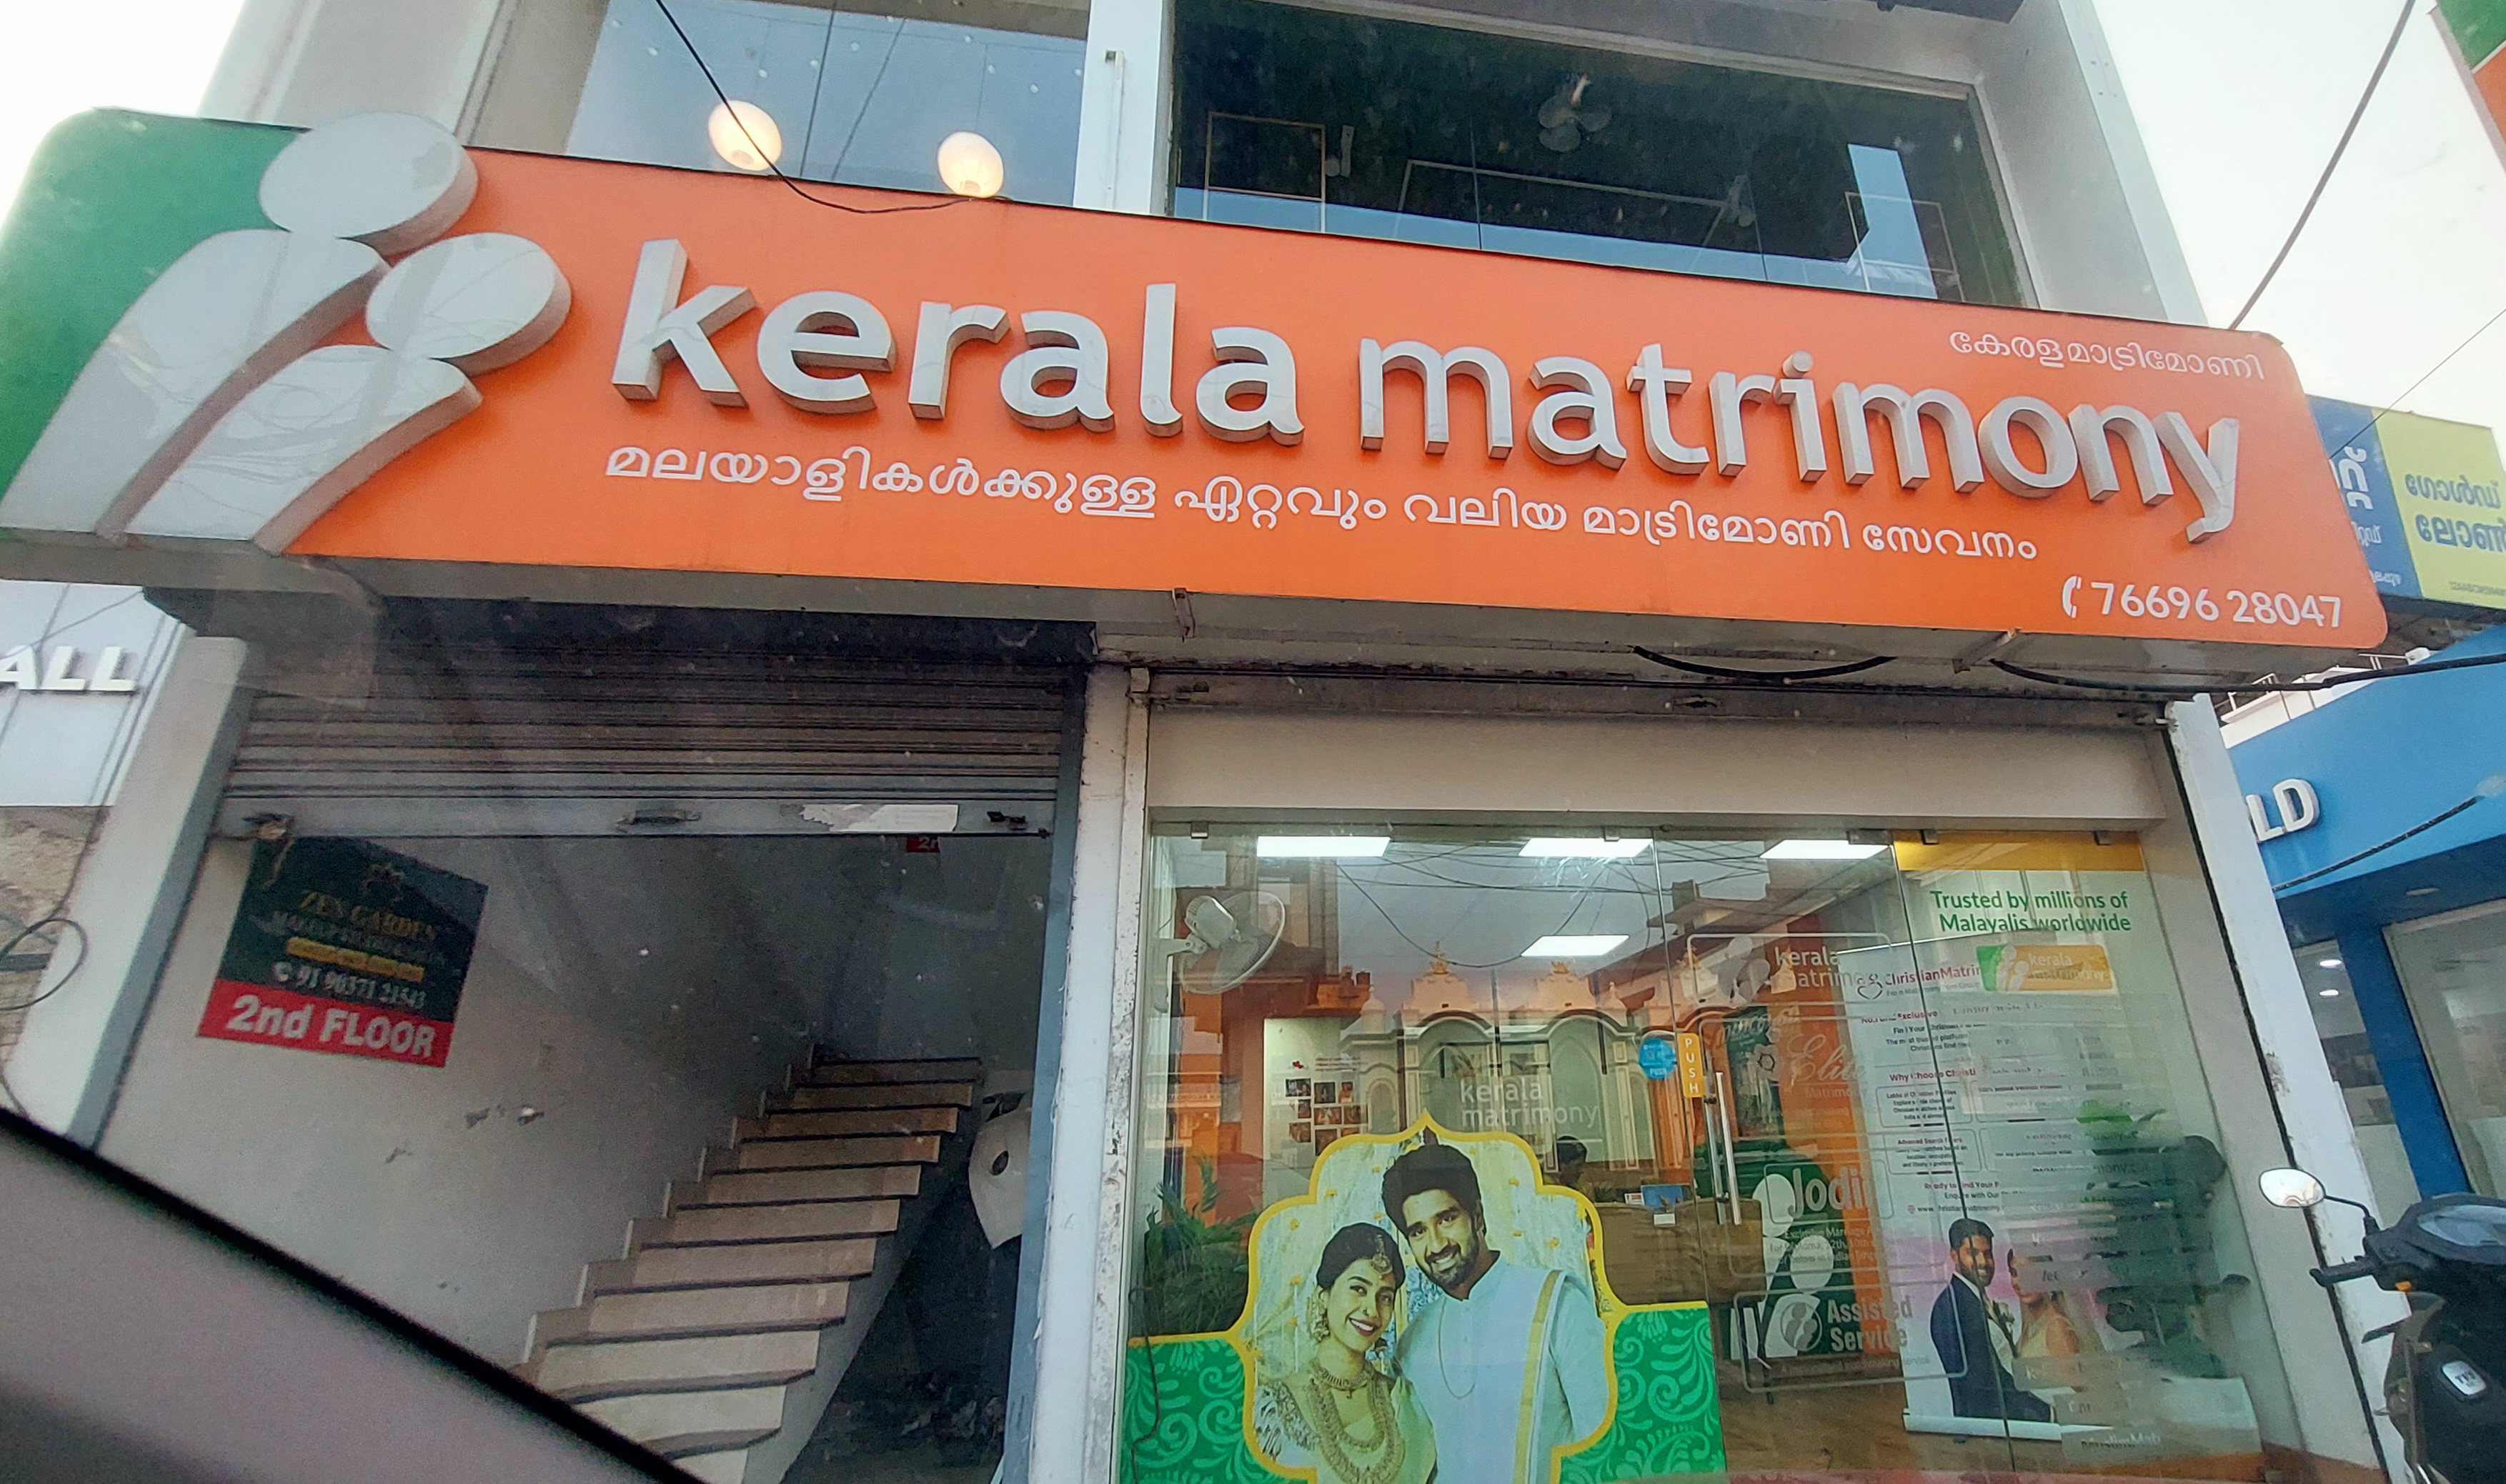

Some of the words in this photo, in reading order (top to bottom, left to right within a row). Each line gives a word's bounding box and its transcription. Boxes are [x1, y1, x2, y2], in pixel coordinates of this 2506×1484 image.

[612, 237, 1304, 447] kerala
[1358, 337, 2239, 544] matrimony
[605, 445, 1157, 519] മലയാളികൾക്കുള്ള
[1175, 475, 1387, 529] ഏറ്റവും
[1404, 488, 1567, 528] വലിയ
[1583, 500, 1851, 549] മാട്രിമോണി
[1862, 522, 2037, 560] സേവനം
[2090, 581, 2220, 621] 76696
[2227, 589, 2341, 627] 28047
[1929, 890, 2002, 908] Trusted
[2007, 891, 2029, 912] by
[2036, 891, 2106, 908] millions
[2110, 891, 2128, 908] of
[1939, 914, 2028, 932] Malayalis
[2033, 913, 2132, 932] worldwide
[1775, 946, 1841, 966] kerala
[2029, 953, 2072, 966] kerala
[227, 995, 313, 1039] 2nd
[319, 1008, 435, 1057] FLOOR
[1685, 1037, 1699, 1094] PUSH
[1461, 1078, 1543, 1103] kerala
[1462, 1102, 1601, 1129] matrimony
[1788, 1166, 1866, 1217] Jodi
